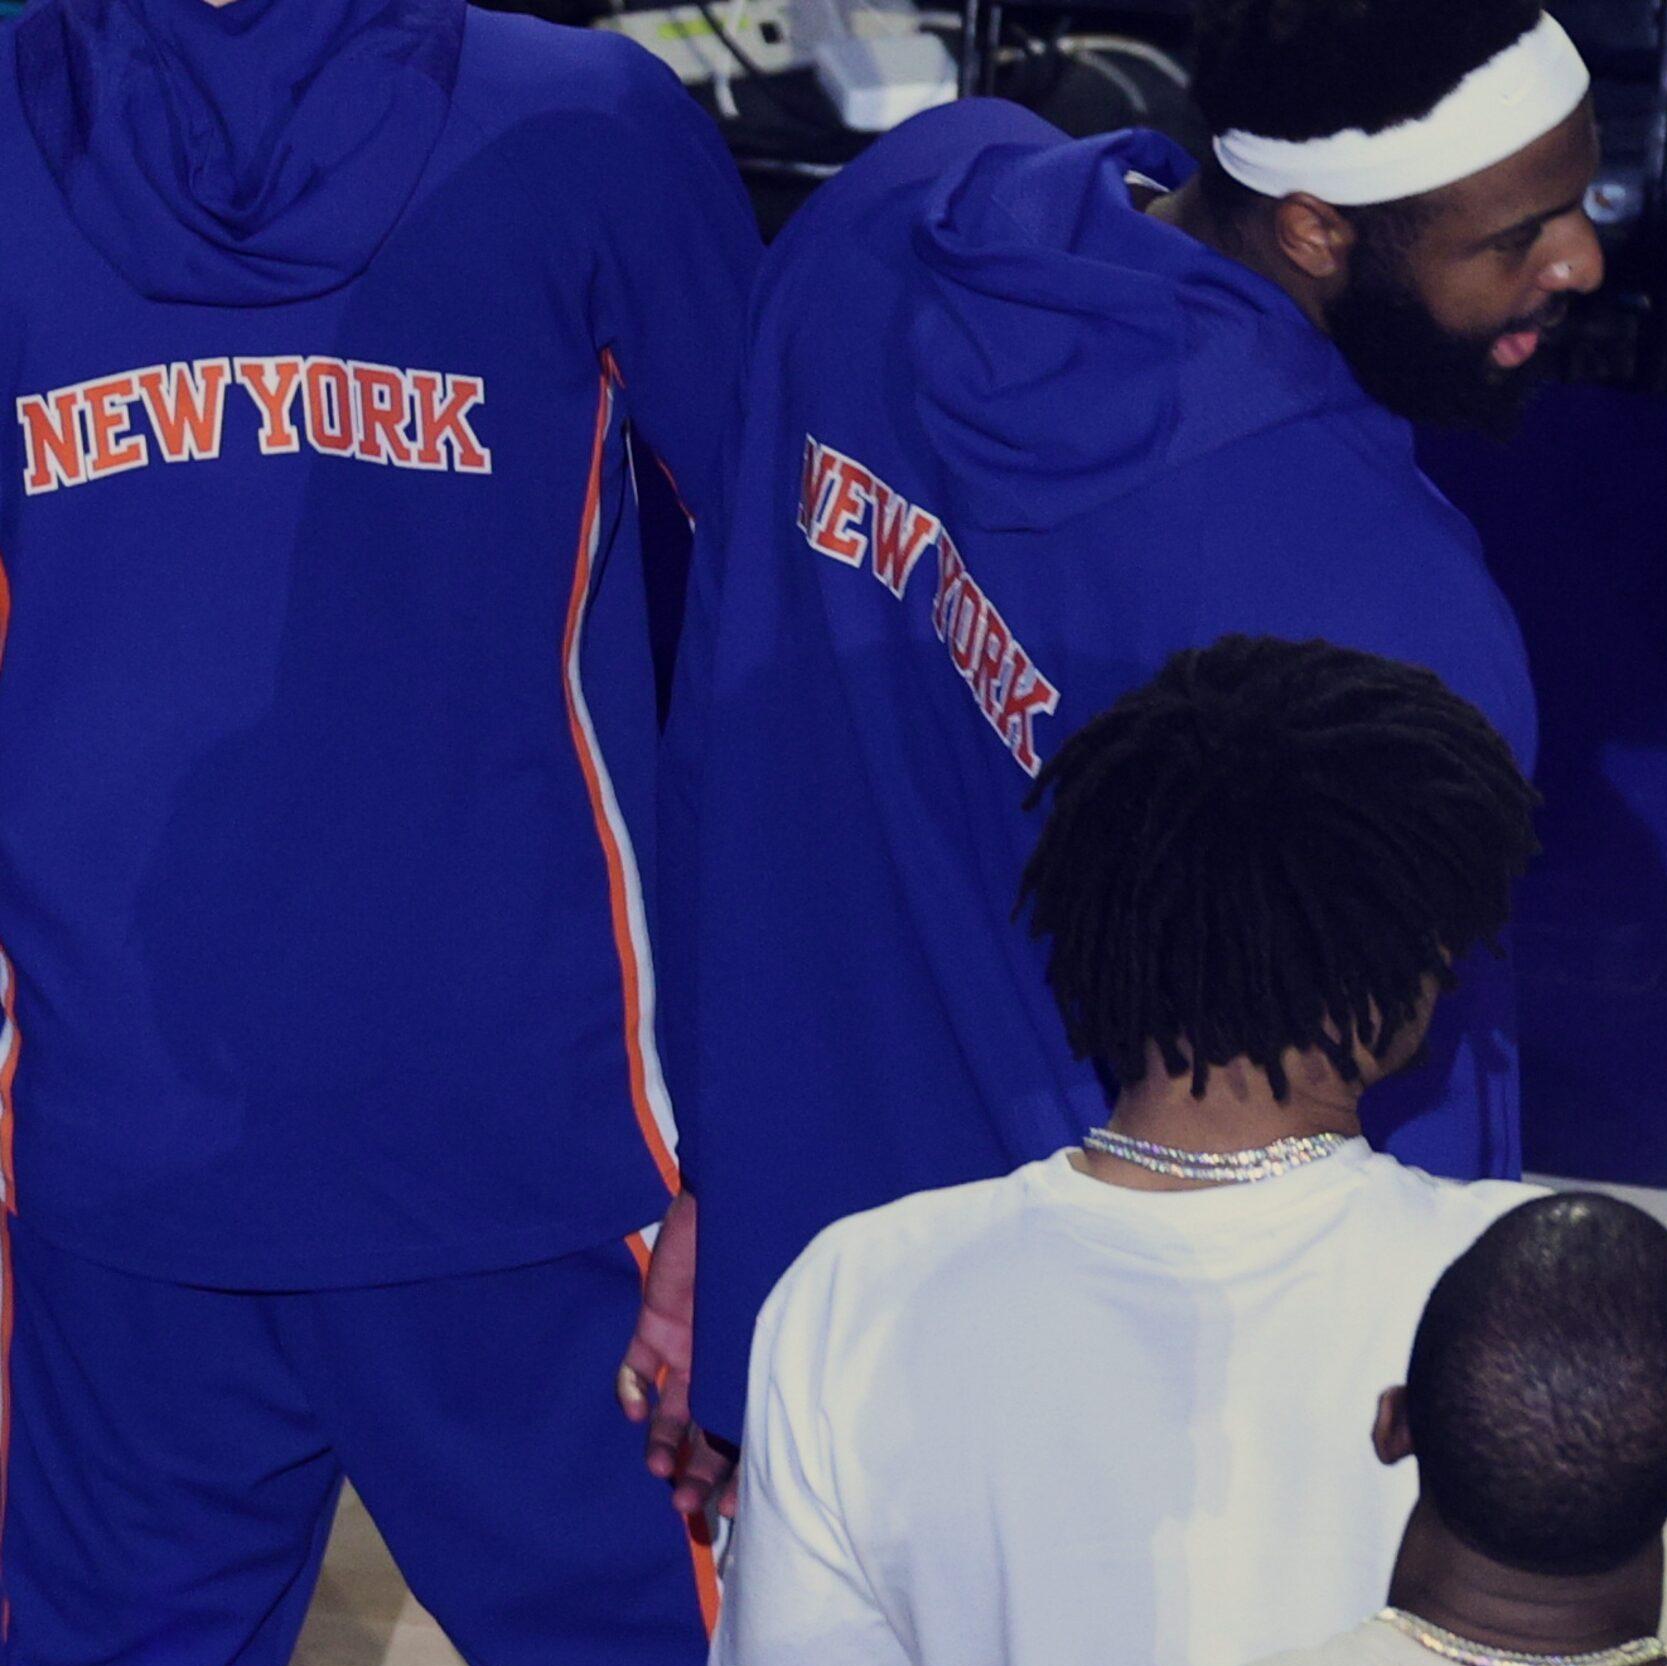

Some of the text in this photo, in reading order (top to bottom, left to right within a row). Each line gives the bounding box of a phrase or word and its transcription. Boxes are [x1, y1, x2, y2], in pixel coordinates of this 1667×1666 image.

[17, 355, 492, 496] NEW YORK
[797, 432, 1060, 778] NEW YORK
